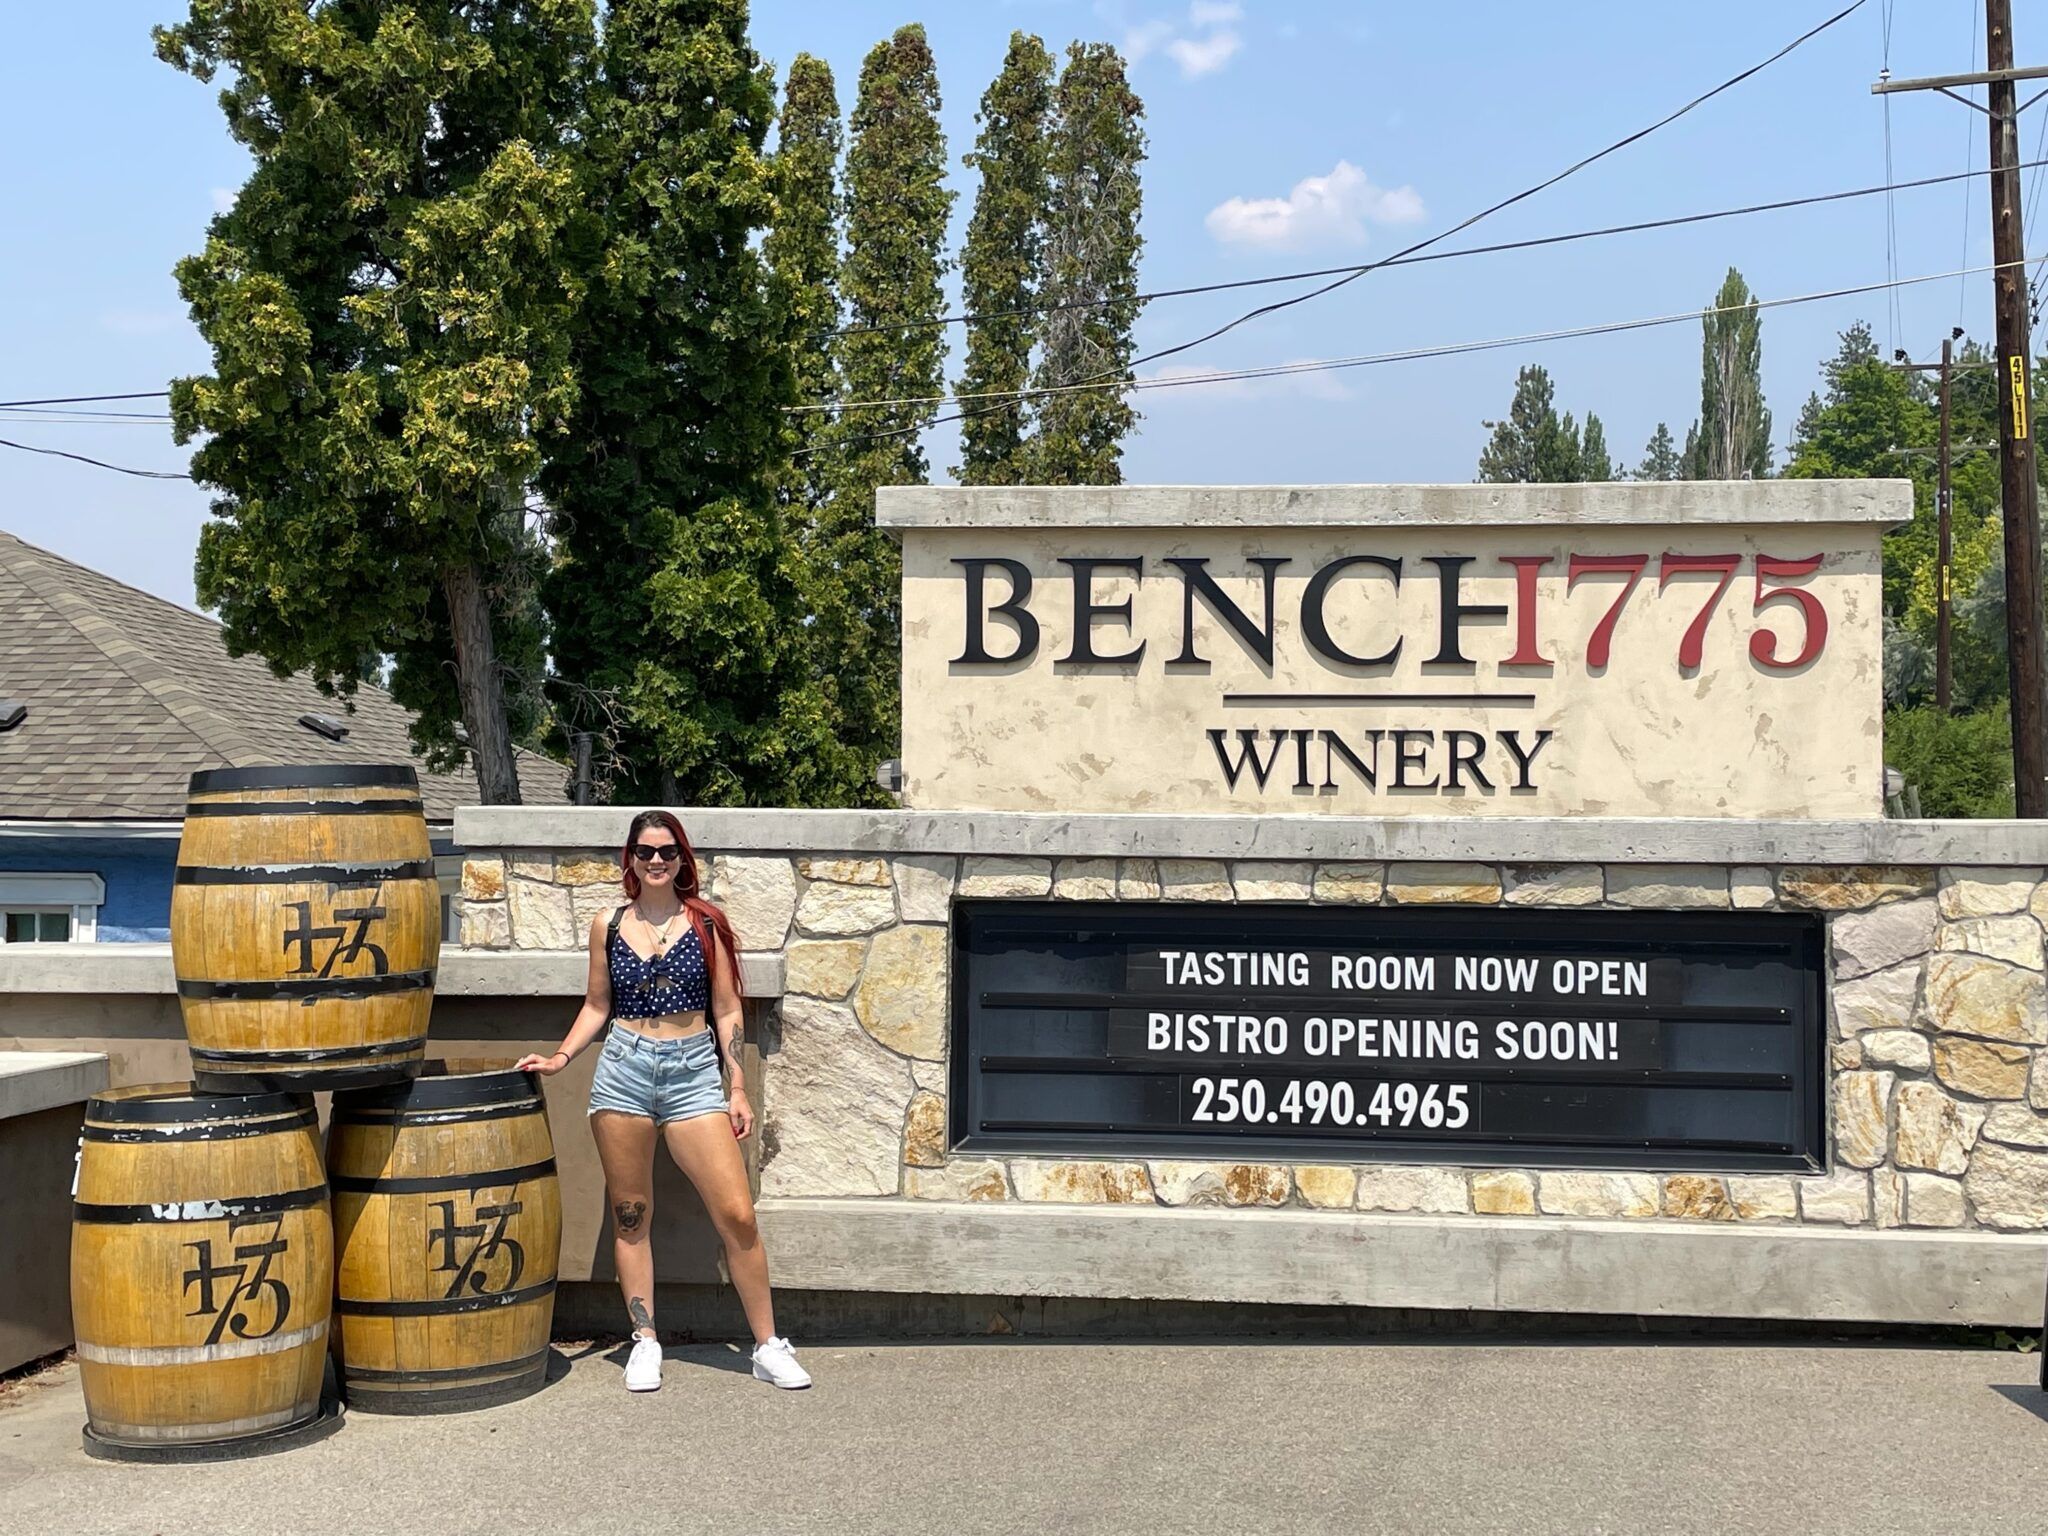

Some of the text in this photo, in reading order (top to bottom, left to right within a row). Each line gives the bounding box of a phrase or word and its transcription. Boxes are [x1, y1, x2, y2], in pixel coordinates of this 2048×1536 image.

[1207, 729, 1553, 792] WINERY
[1160, 951, 1648, 996] TASTING ROOM NOW OPEN
[1147, 1012, 1619, 1060] BISTRO OPENING SOON!
[1191, 1077, 1470, 1129] 250.490.4965
